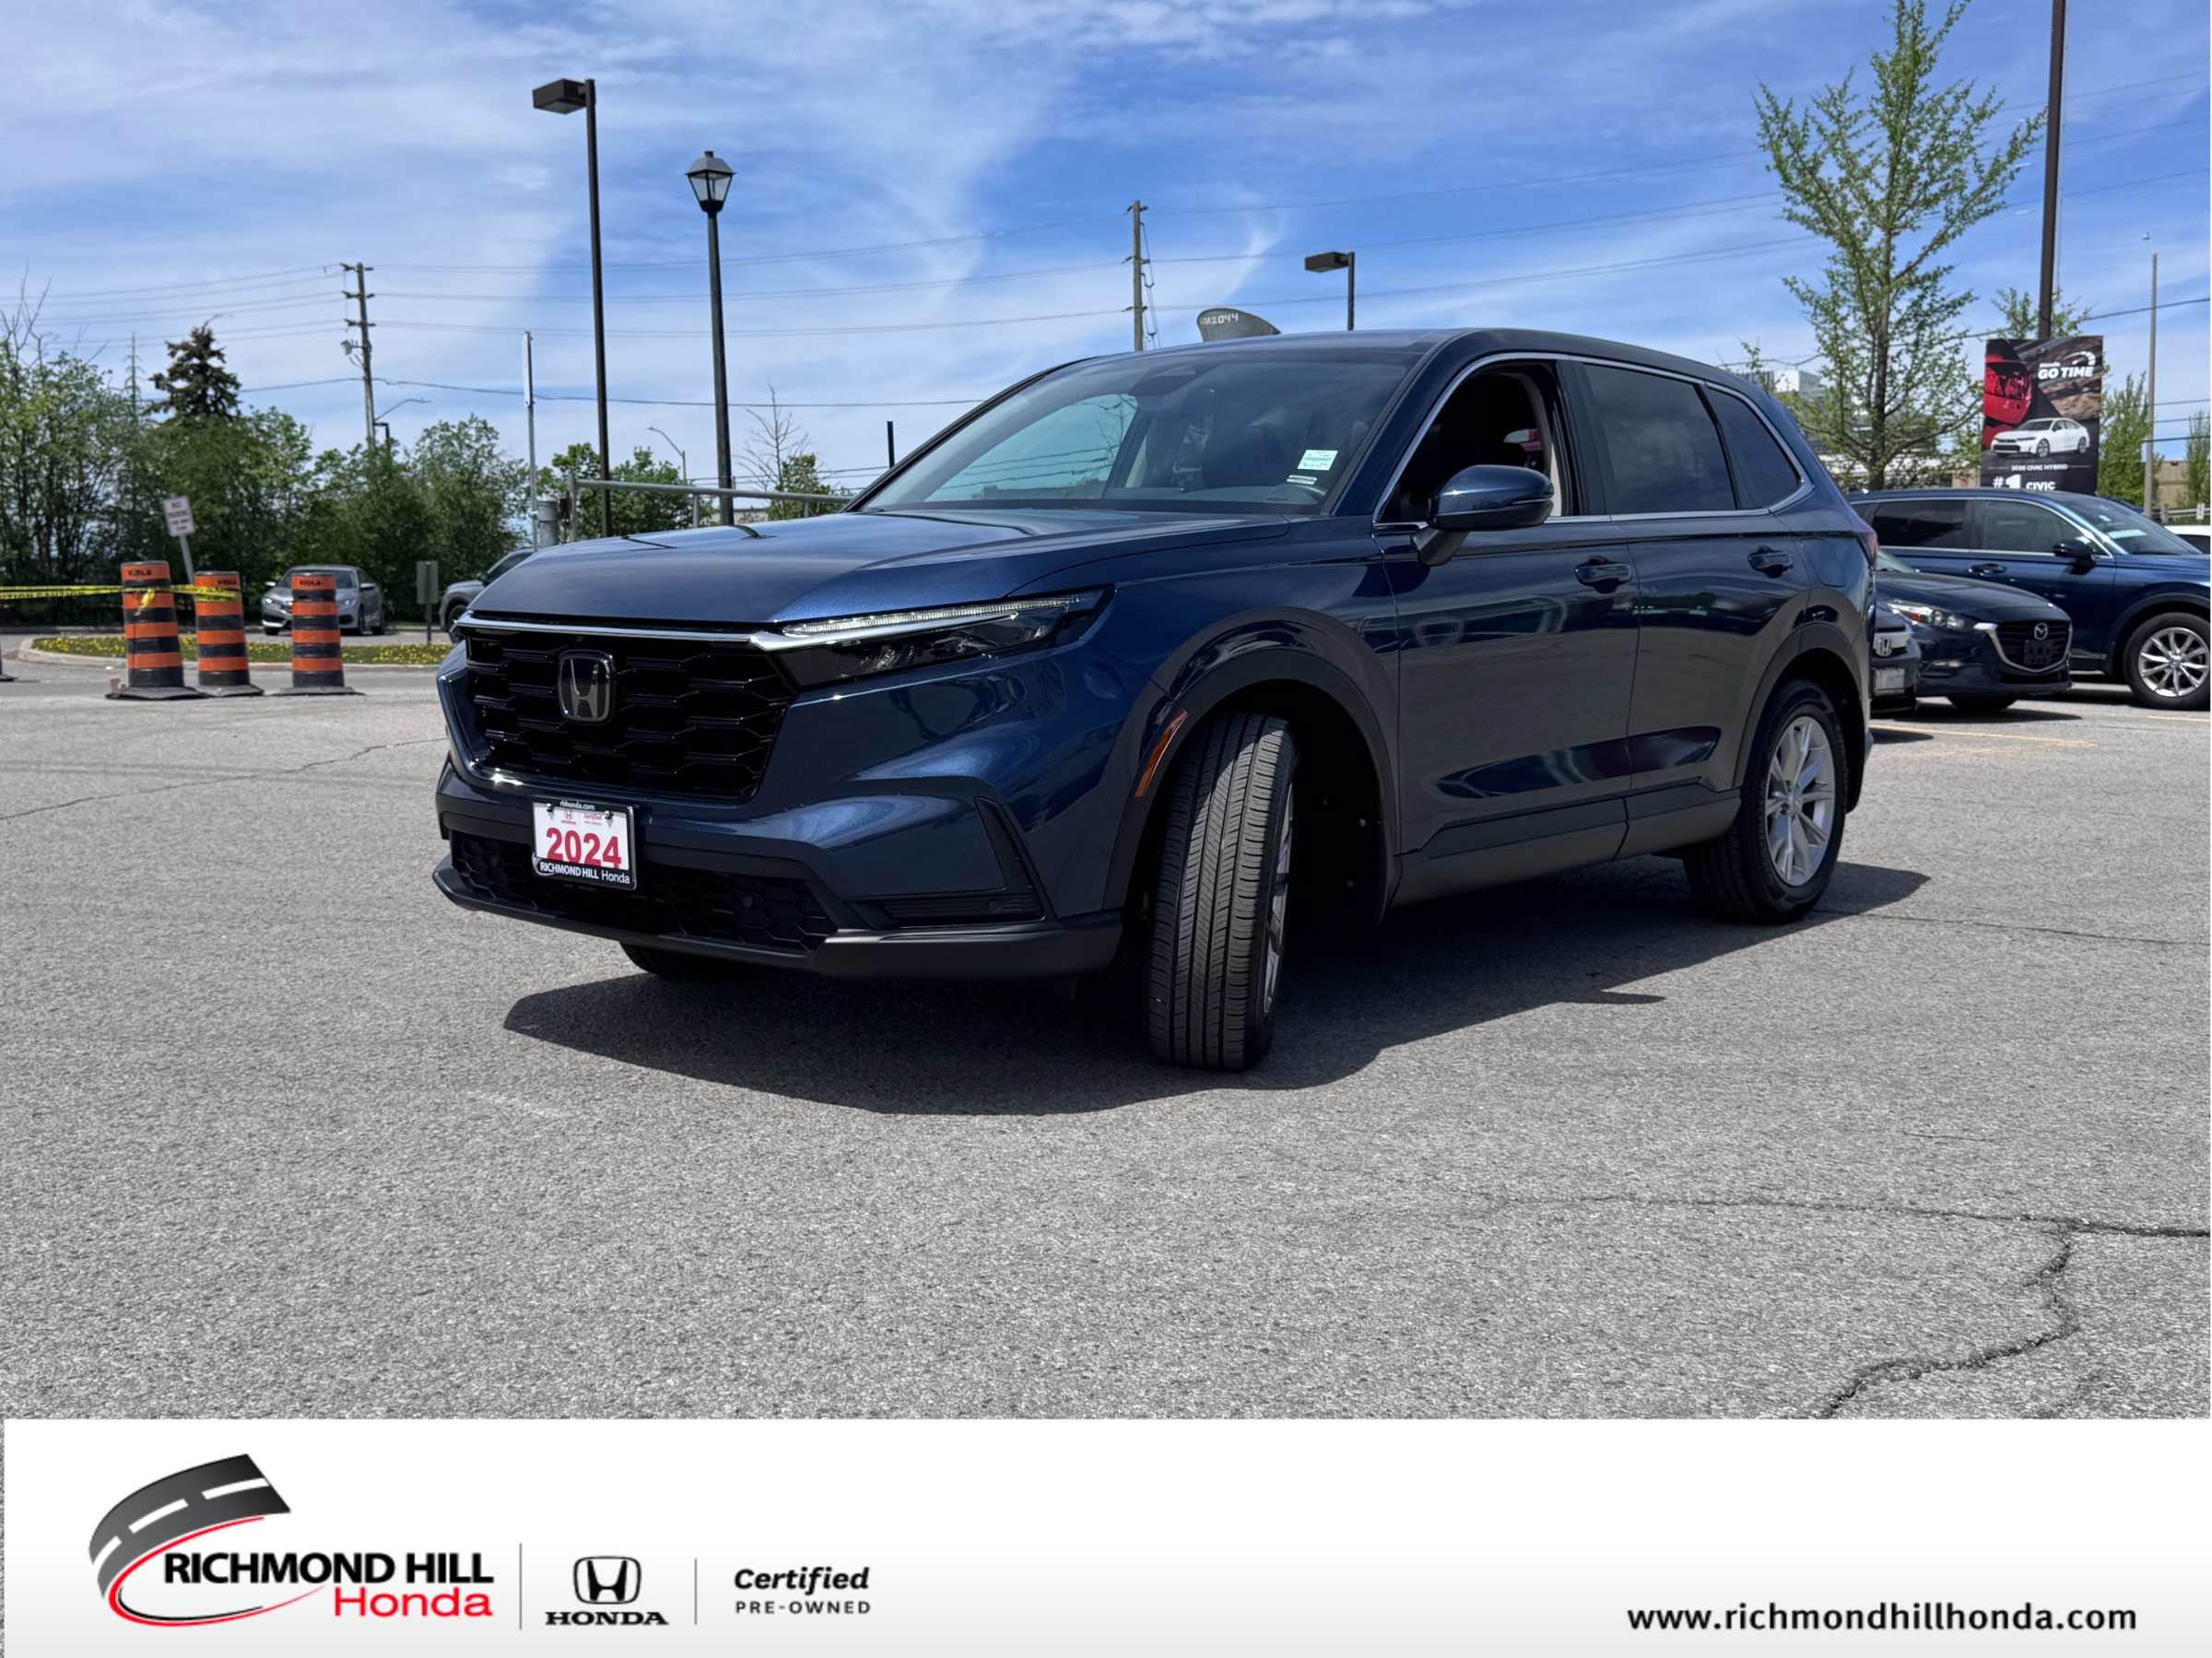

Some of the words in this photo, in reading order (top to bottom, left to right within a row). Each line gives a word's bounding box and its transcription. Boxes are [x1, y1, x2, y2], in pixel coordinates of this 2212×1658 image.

[2038, 368, 2059, 380] GO
[2061, 366, 2095, 378] TIME
[2044, 463, 2069, 471] HYBRID
[2026, 481, 2057, 490] CIVIC
[559, 799, 595, 811] rhhonda.com
[546, 827, 622, 870] 2024
[540, 861, 582, 877] RICHMOND
[582, 867, 600, 879] HILL
[601, 869, 630, 885] Honda
